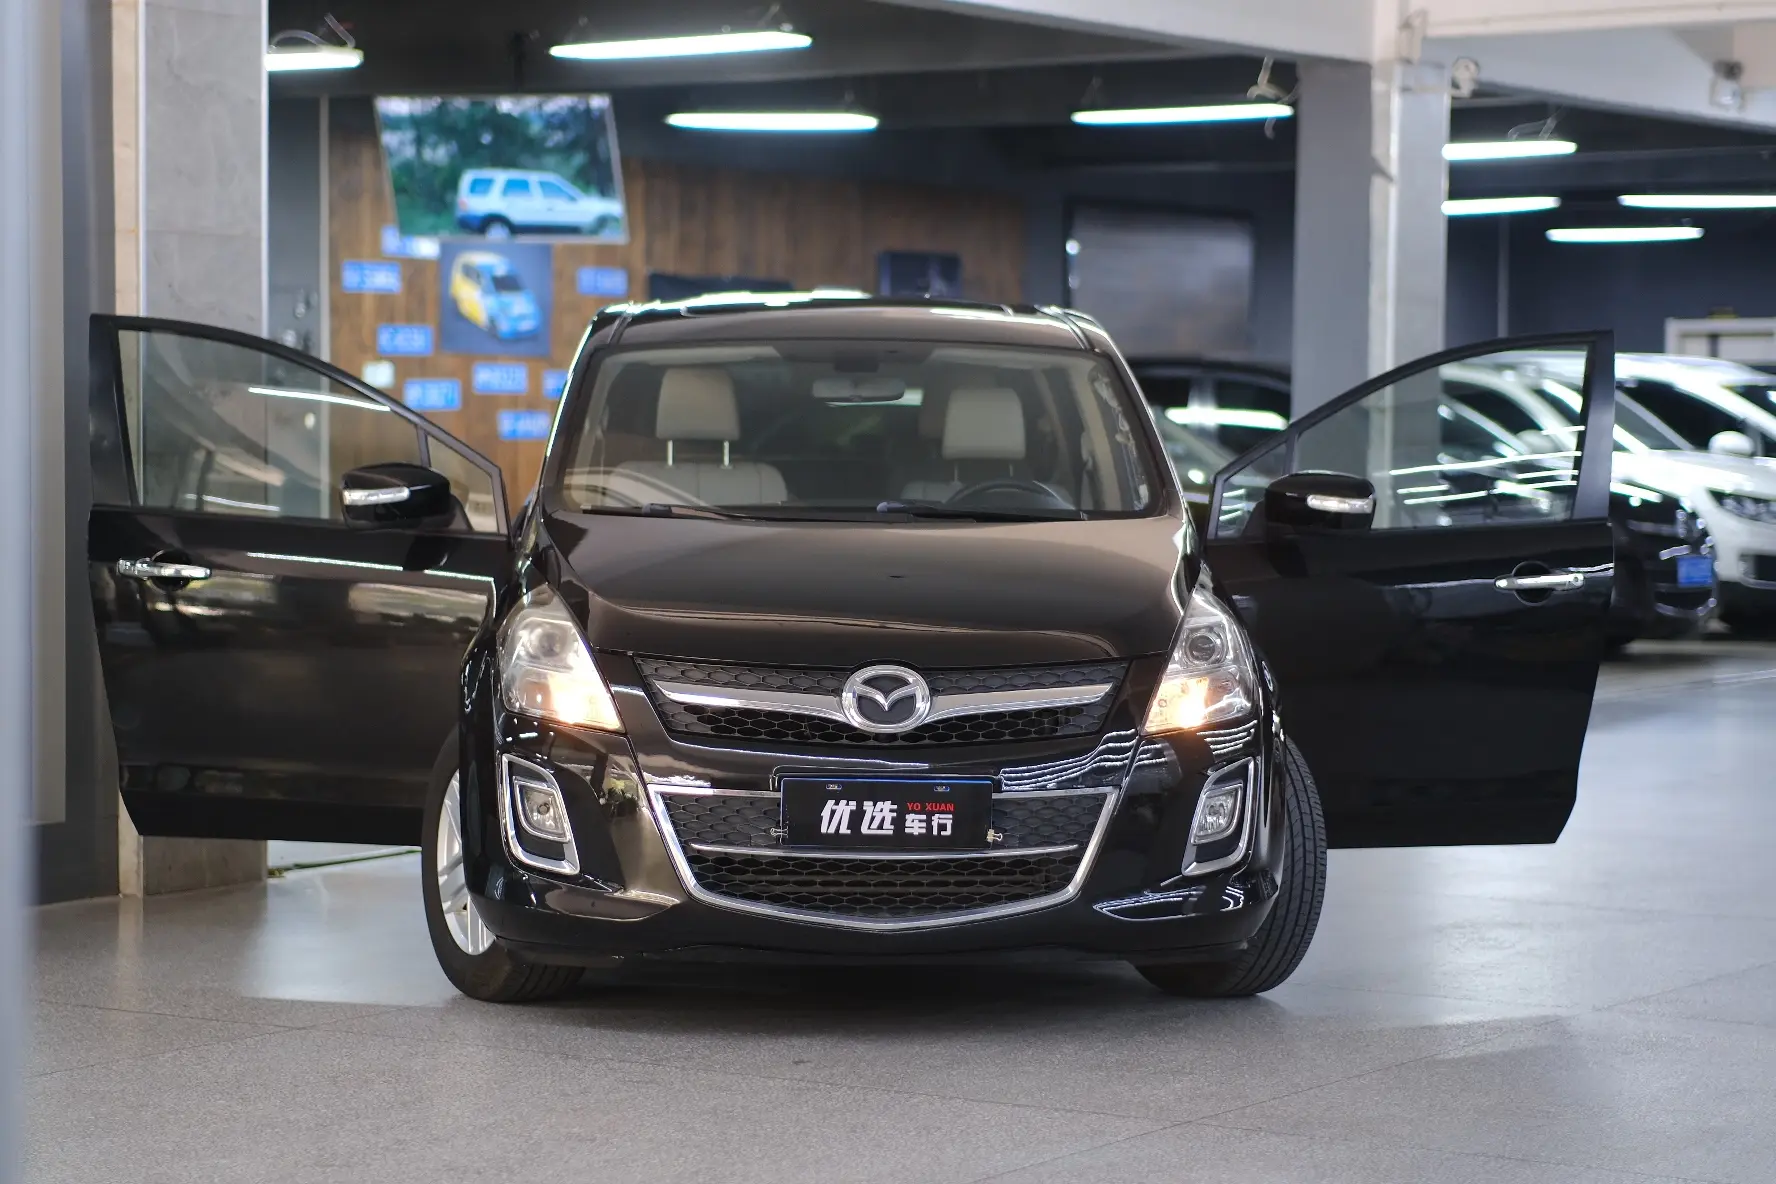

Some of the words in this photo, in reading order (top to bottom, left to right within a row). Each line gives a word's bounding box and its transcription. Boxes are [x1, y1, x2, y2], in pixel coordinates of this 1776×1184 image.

[820, 799, 897, 835] 优选
[907, 802, 922, 811] YO
[925, 802, 954, 812] XUAN
[904, 813, 953, 836] 车行
